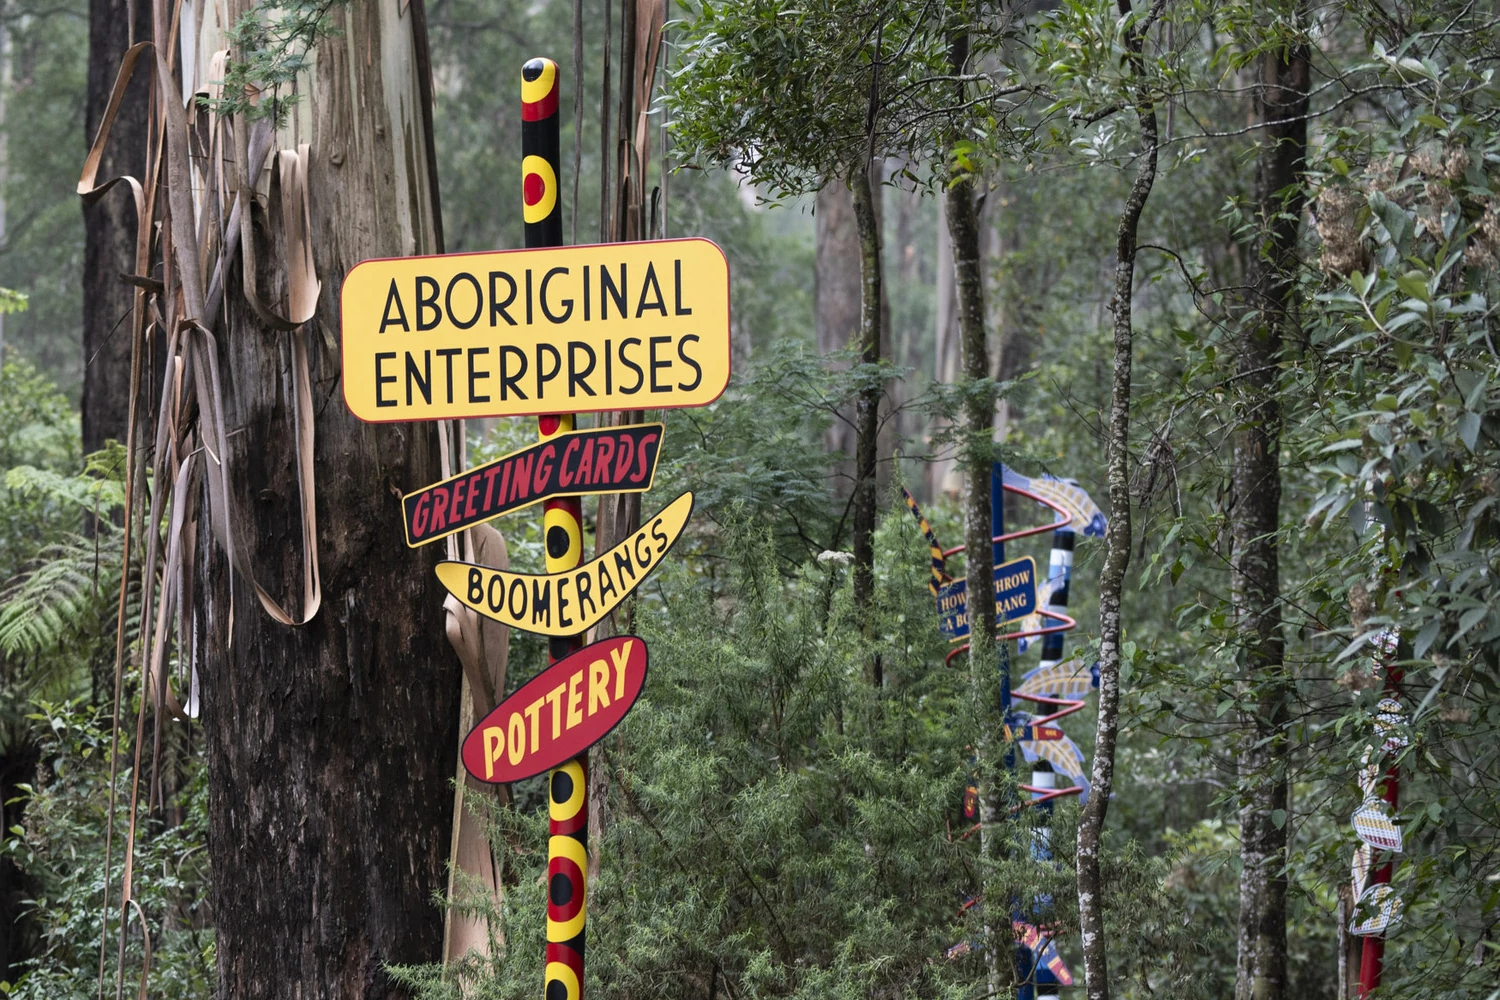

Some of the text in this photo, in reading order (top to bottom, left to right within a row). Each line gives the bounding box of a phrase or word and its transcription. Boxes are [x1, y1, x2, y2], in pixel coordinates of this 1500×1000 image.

[378, 259, 693, 334] ABORIGINAL
[374, 333, 703, 408] ENTERPRISES
[412, 432, 656, 538] GREETING CARDS
[467, 518, 668, 628] BOOMERANGS
[993, 570, 1030, 593] HROW
[483, 640, 633, 780] POTTERY
